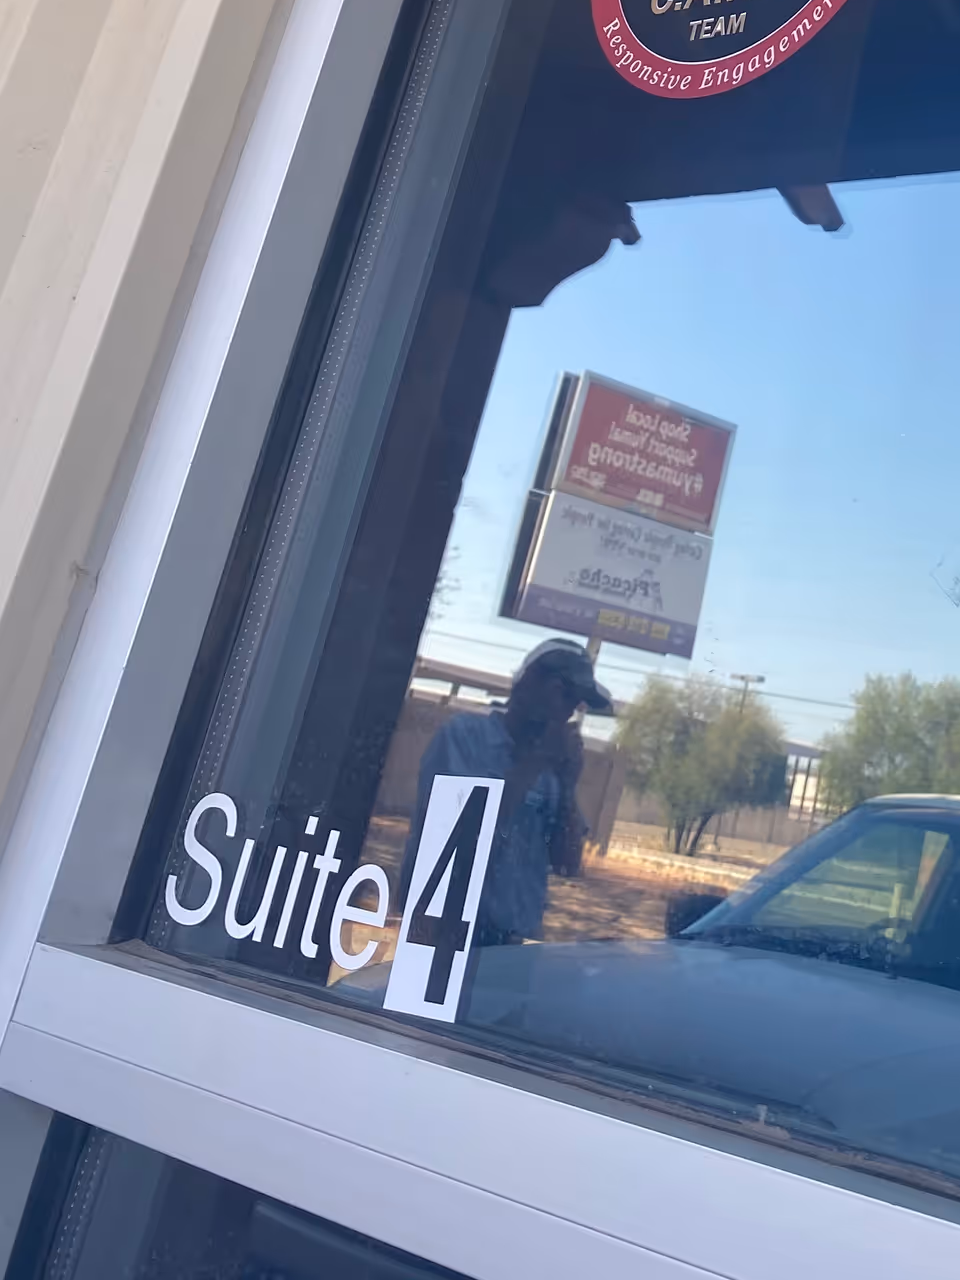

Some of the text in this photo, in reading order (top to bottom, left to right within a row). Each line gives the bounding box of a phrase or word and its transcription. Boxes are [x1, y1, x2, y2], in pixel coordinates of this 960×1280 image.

[603, 18, 691, 90] Responsive
[689, 12, 746, 41] TEAM
[165, 786, 489, 1006] Suite 4
